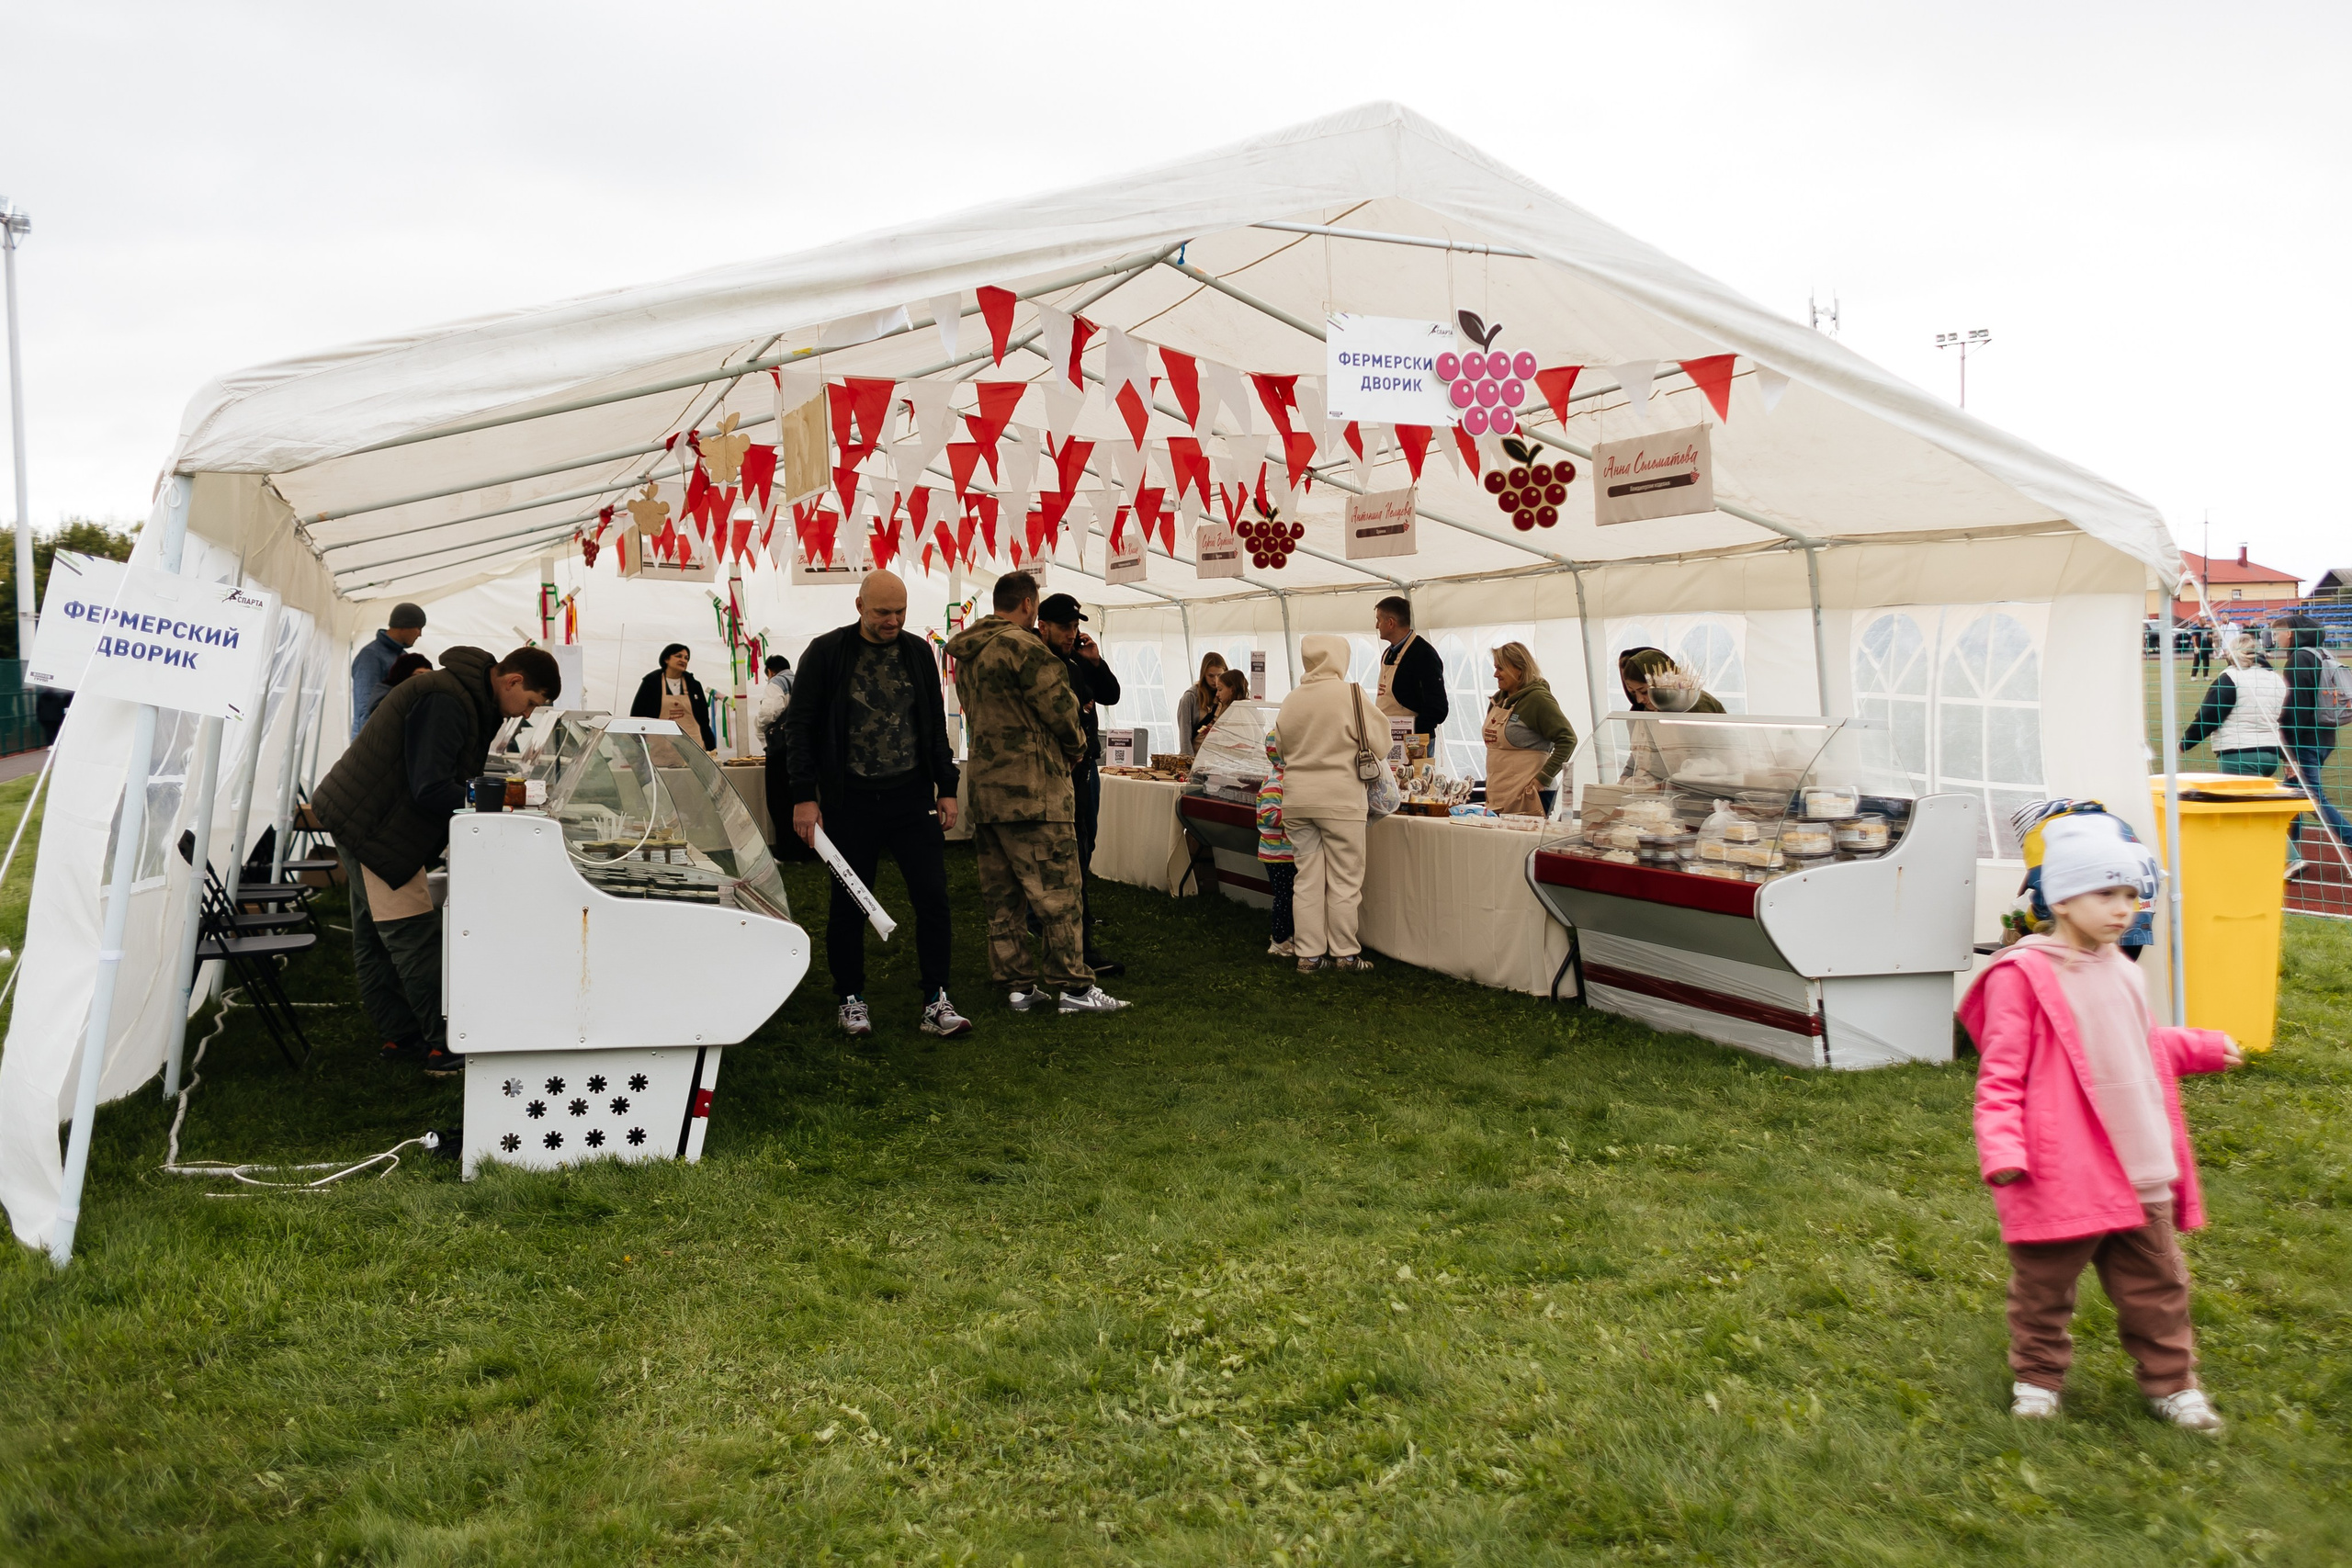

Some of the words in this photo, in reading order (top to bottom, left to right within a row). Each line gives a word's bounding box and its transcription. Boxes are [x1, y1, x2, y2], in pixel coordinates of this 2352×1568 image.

[1339, 351, 1432, 371] ФЕРМЕРСКИ
[1361, 375, 1422, 392] ДВОРИК
[1603, 456, 1631, 479] Анна
[1634, 444, 1698, 474] Соломатова
[237, 596, 263, 607] СПАРТА
[63, 600, 240, 649] ФЕРМЕРСКИЙ
[94, 636, 199, 670] ДВОРИК
